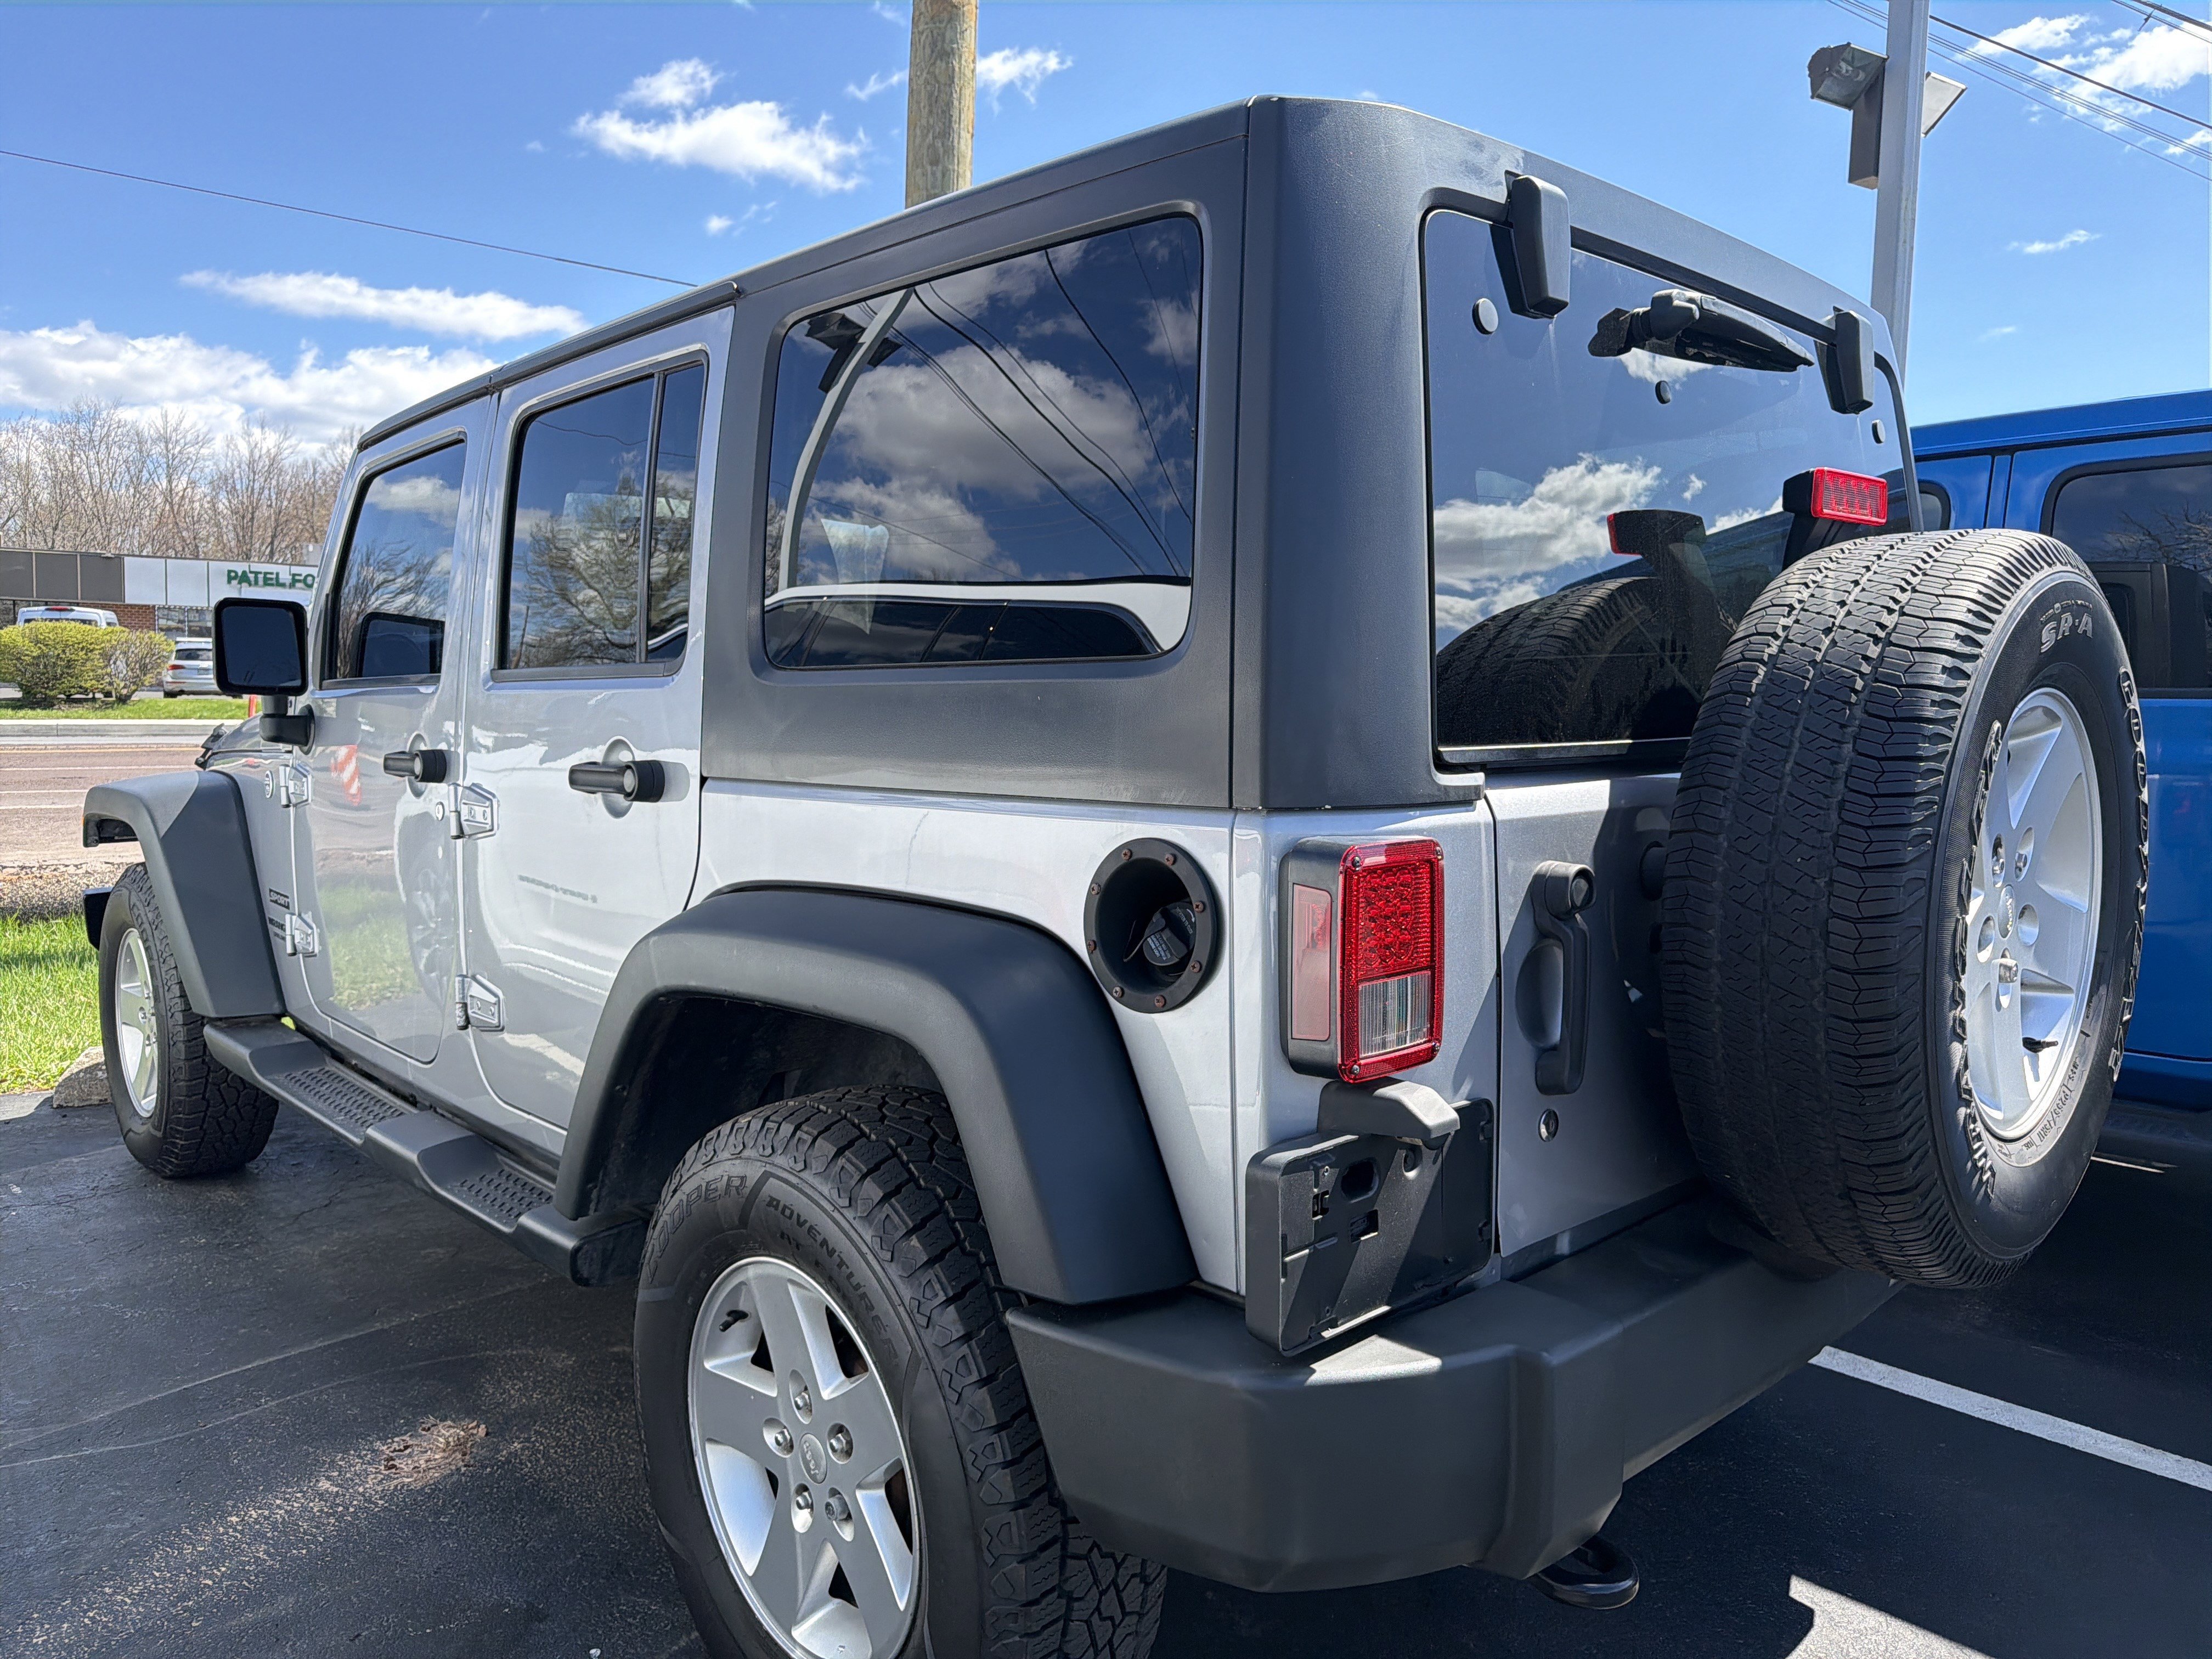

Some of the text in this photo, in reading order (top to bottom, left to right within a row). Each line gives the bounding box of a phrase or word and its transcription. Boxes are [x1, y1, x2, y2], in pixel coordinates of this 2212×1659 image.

[227, 569, 286, 587] PATEL
[269, 891, 289, 907] SPORT
[646, 1173, 748, 1284] COOPER
